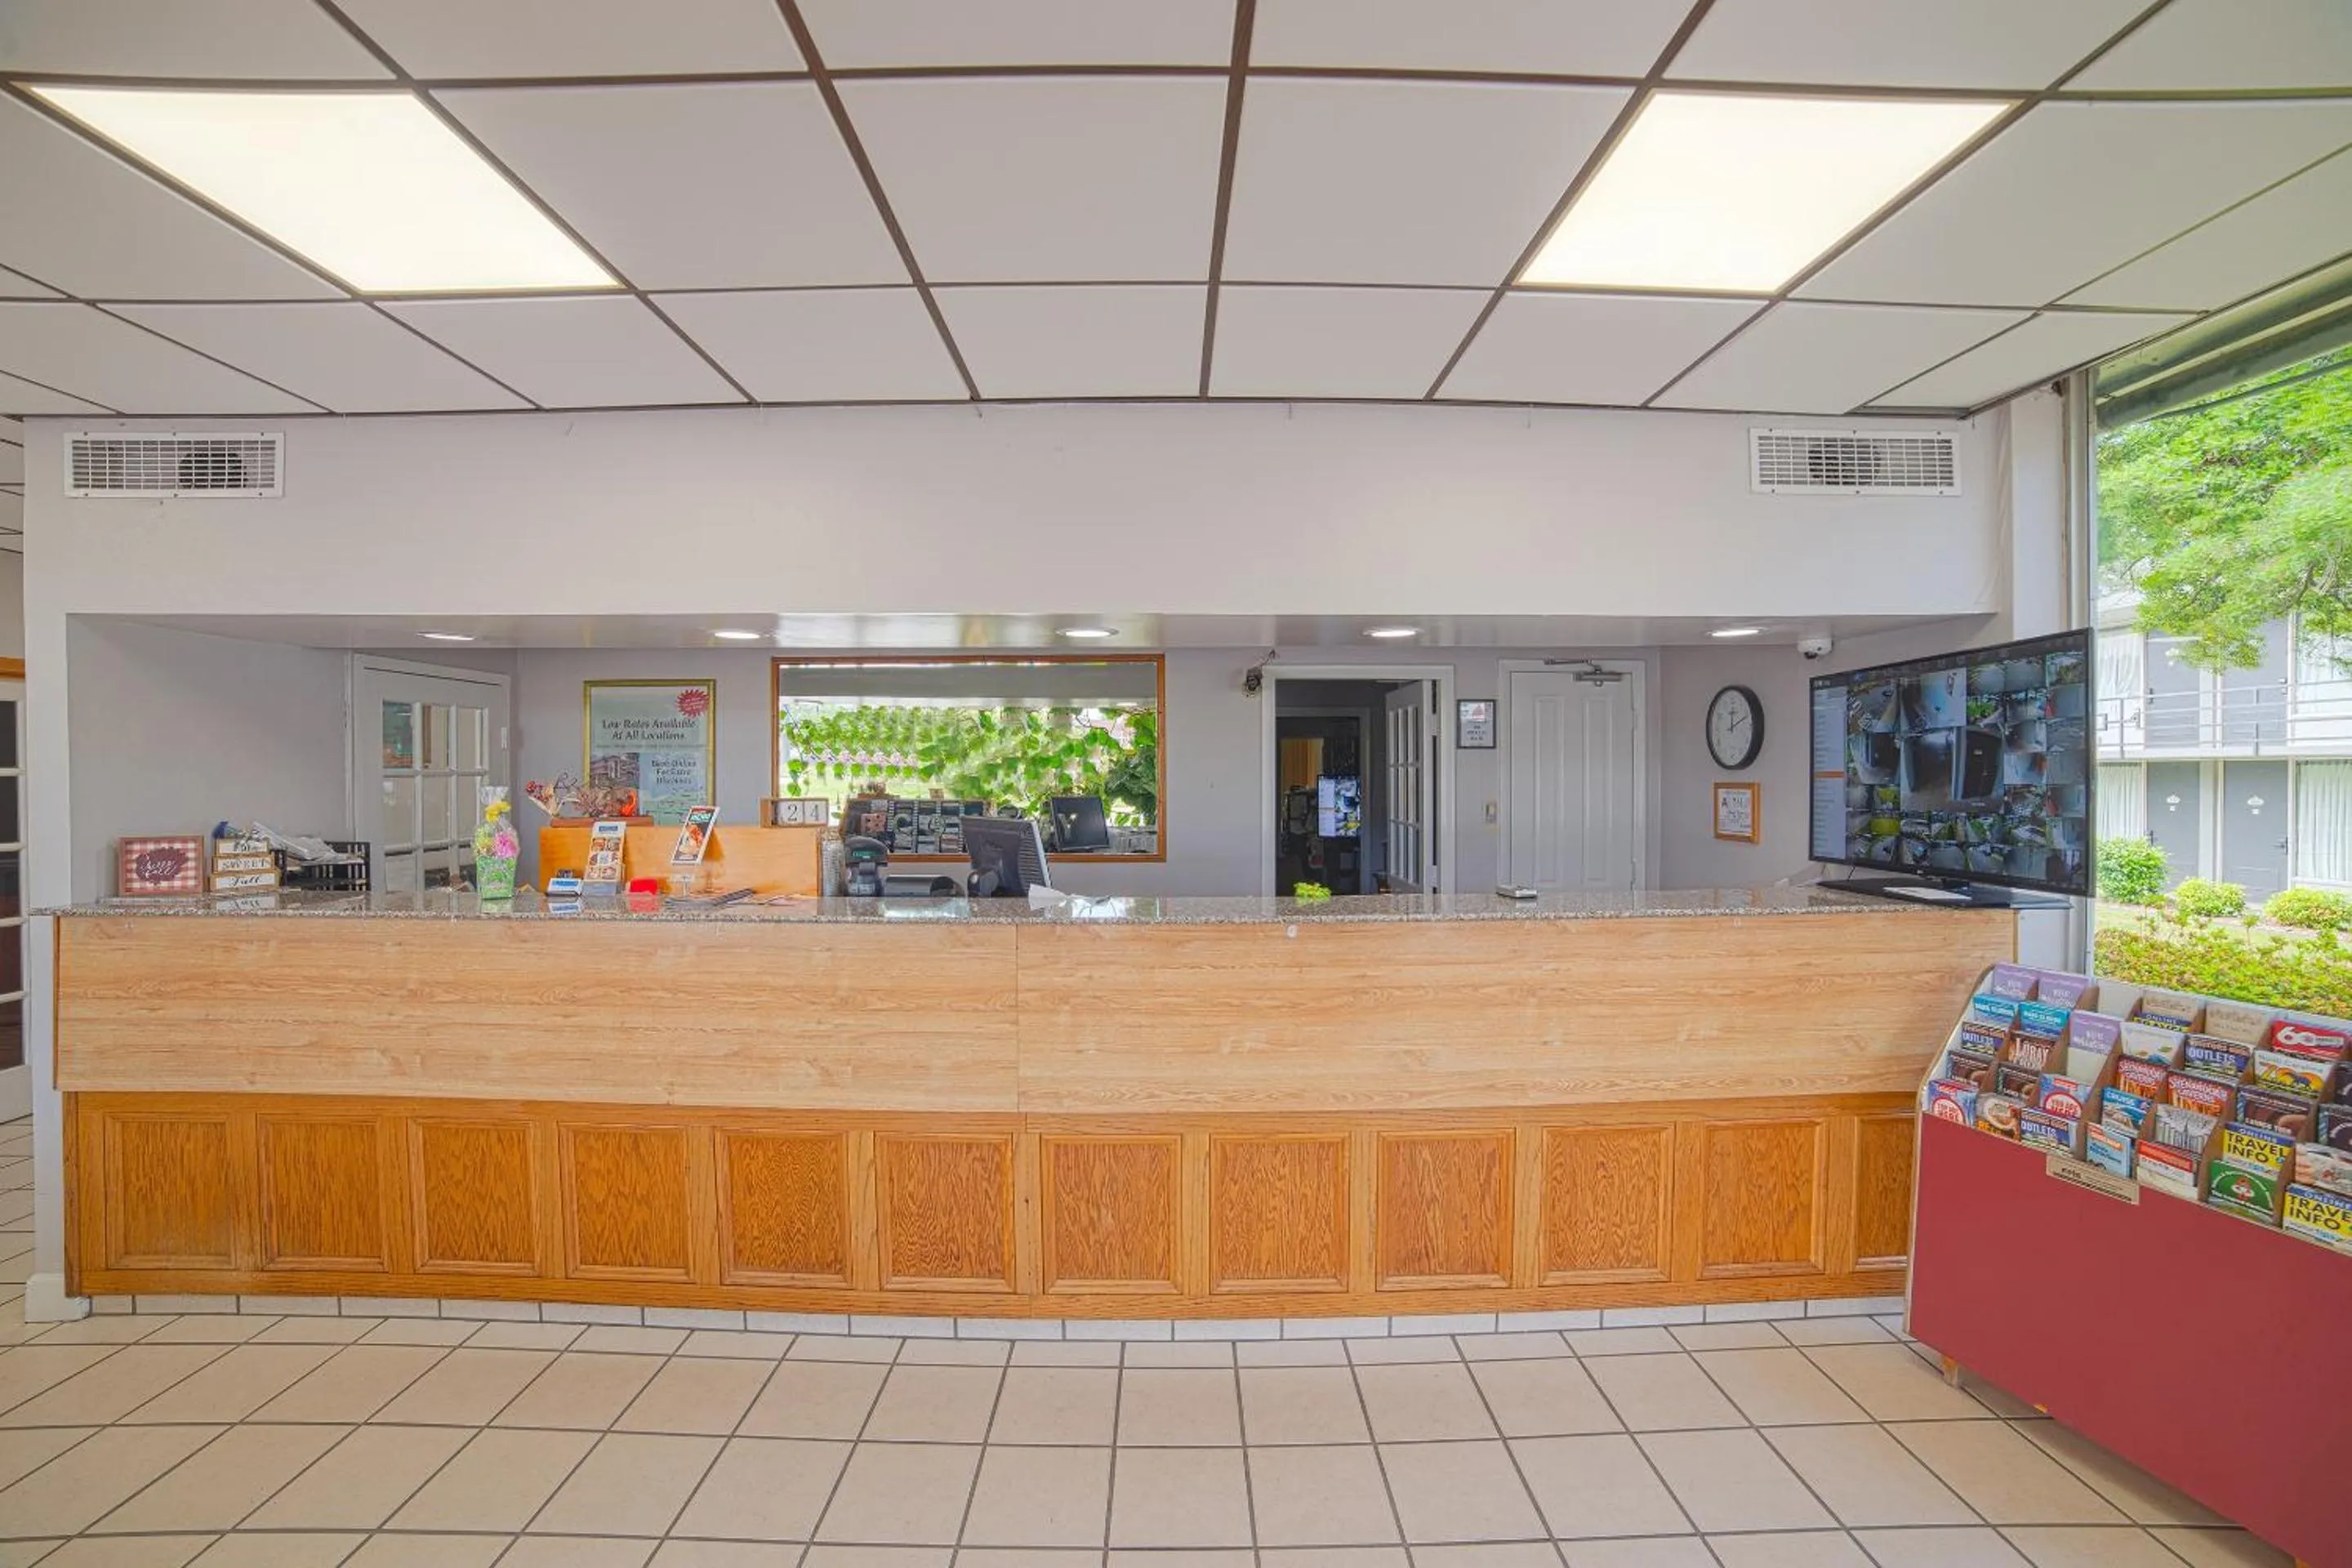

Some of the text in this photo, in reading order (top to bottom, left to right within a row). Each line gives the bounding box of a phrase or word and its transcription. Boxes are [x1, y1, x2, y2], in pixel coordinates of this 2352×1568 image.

[2187, 1046, 2236, 1063] OUTLETS
[2020, 1120, 2057, 1137] OUTLETS
[2228, 1143, 2270, 1163] INFO
[2229, 1132, 2284, 1158] TRAVEL
[2288, 1194, 2352, 1223] TRAVE
[2289, 1205, 2341, 1230] INFO
